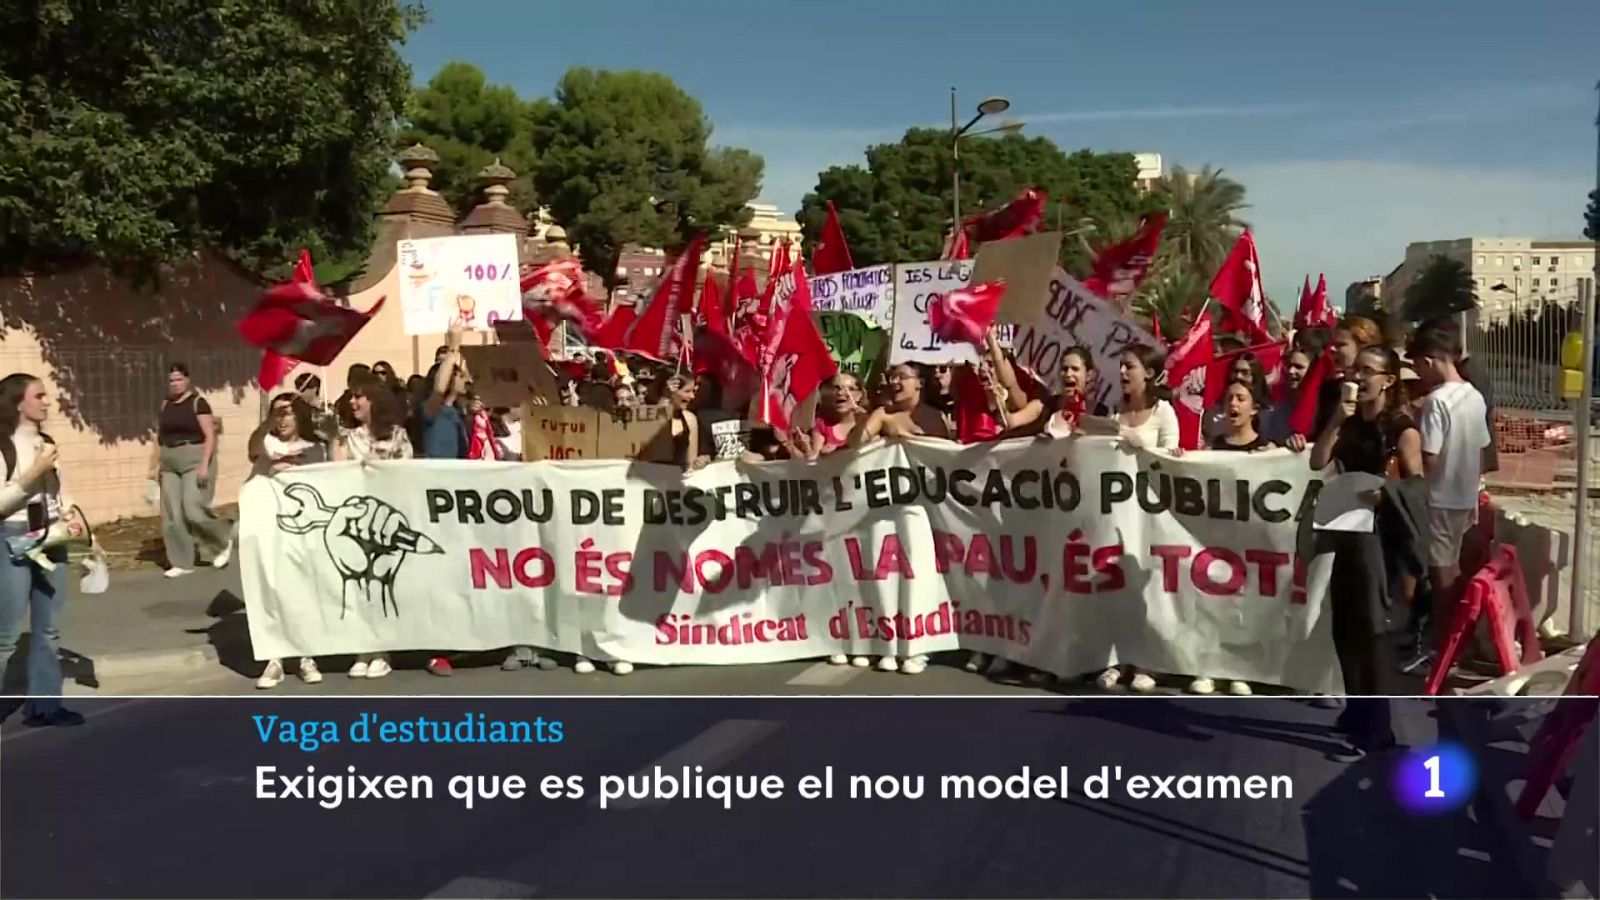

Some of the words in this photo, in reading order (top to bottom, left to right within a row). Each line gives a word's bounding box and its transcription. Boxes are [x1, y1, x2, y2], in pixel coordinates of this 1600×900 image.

[905, 267, 932, 284] IES
[427, 488, 553, 524] PROU
[571, 489, 625, 525] DE
[643, 479, 823, 526] DESTRUIR
[833, 457, 1081, 513] L'EDUCACIÓ
[470, 547, 556, 590] NO
[575, 537, 635, 597] ÉS
[652, 534, 833, 595] NOMÉS
[844, 533, 915, 582] LA
[933, 533, 1050, 592] PAU,
[1063, 526, 1126, 596] ÉS
[1151, 544, 1308, 605] TOT!
[655, 611, 807, 646] Sindicat
[828, 601, 1034, 647] d'Estudiants
